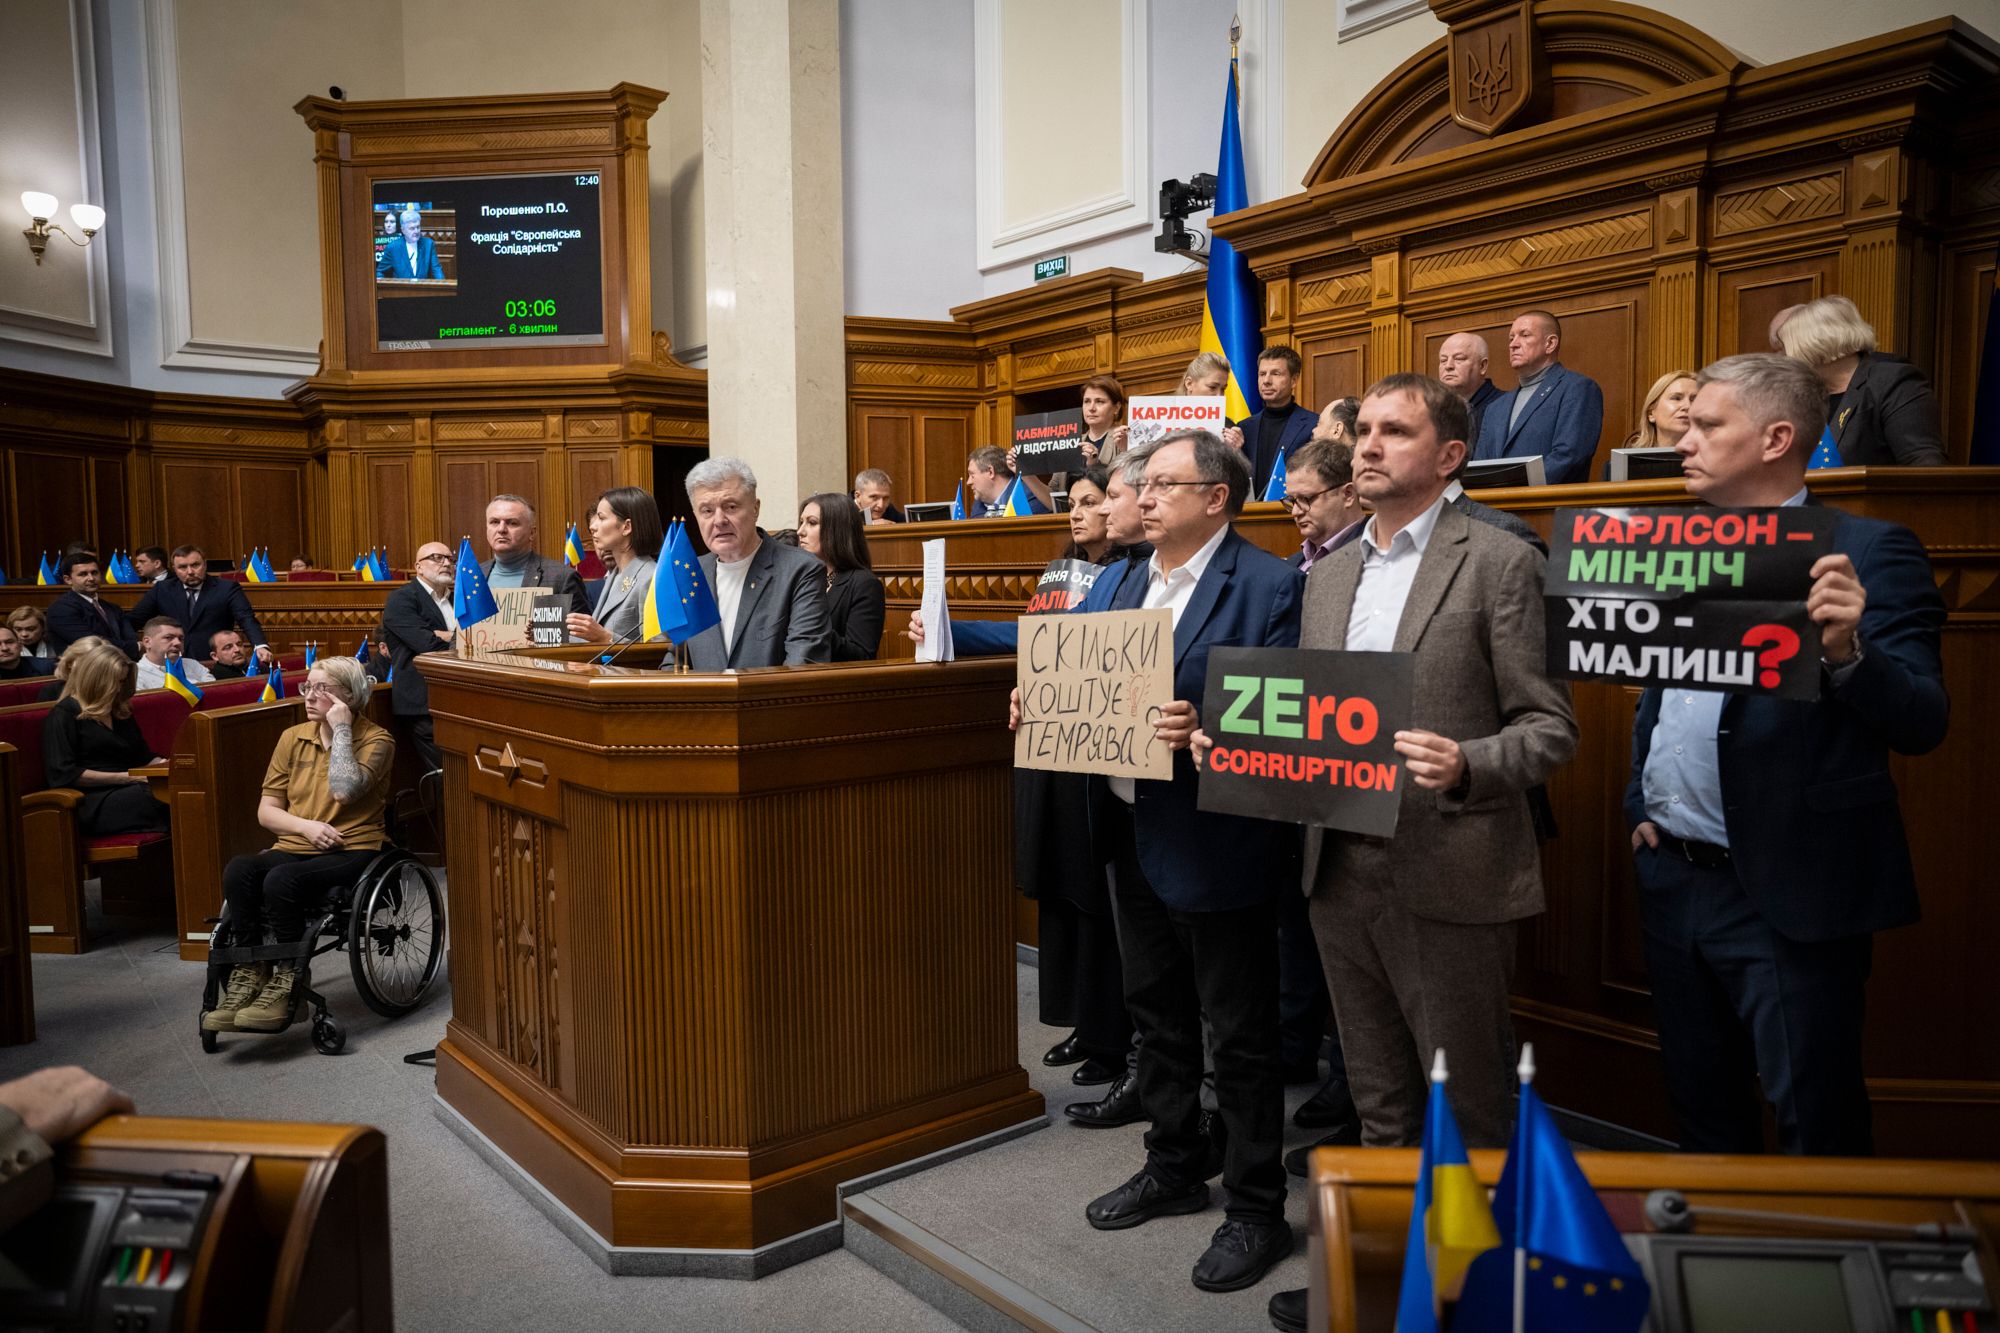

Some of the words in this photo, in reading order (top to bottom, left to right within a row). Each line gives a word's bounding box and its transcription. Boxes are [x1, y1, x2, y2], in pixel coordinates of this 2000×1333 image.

[575, 176, 599, 186] 12:40
[481, 205, 543, 218] Порошенко
[546, 203, 569, 214] П.О.
[471, 231, 509, 243] Фракція
[511, 229, 581, 243] "Європейська
[492, 242, 562, 255] Солідарність"
[1037, 258, 1064, 274] ВИХІД
[505, 299, 556, 318] 03:06
[439, 325, 497, 338] регламент
[509, 324, 517, 334] 6
[520, 323, 558, 334] хвилин
[1132, 406, 1220, 420] КАРЛСОН
[1016, 422, 1078, 441] КАБМІНДІЧ
[1015, 443, 1022, 455] У
[1023, 438, 1081, 455] ВІДСТАВКУ
[1572, 514, 1778, 545] КАРЛСОН
[1037, 569, 1069, 587] ЕННЯ
[1567, 549, 1745, 593] МІНДІЧ
[533, 606, 562, 622] СКІЛЬКИ
[1566, 598, 1660, 634] ХТО
[533, 627, 562, 643] КОШТУЄ
[1031, 621, 1160, 673] СКІЛЬКИ
[1022, 678, 1123, 719] КОШТУЄ
[1219, 674, 1379, 746] ZEro
[1209, 747, 1398, 792] CORRUPTION
